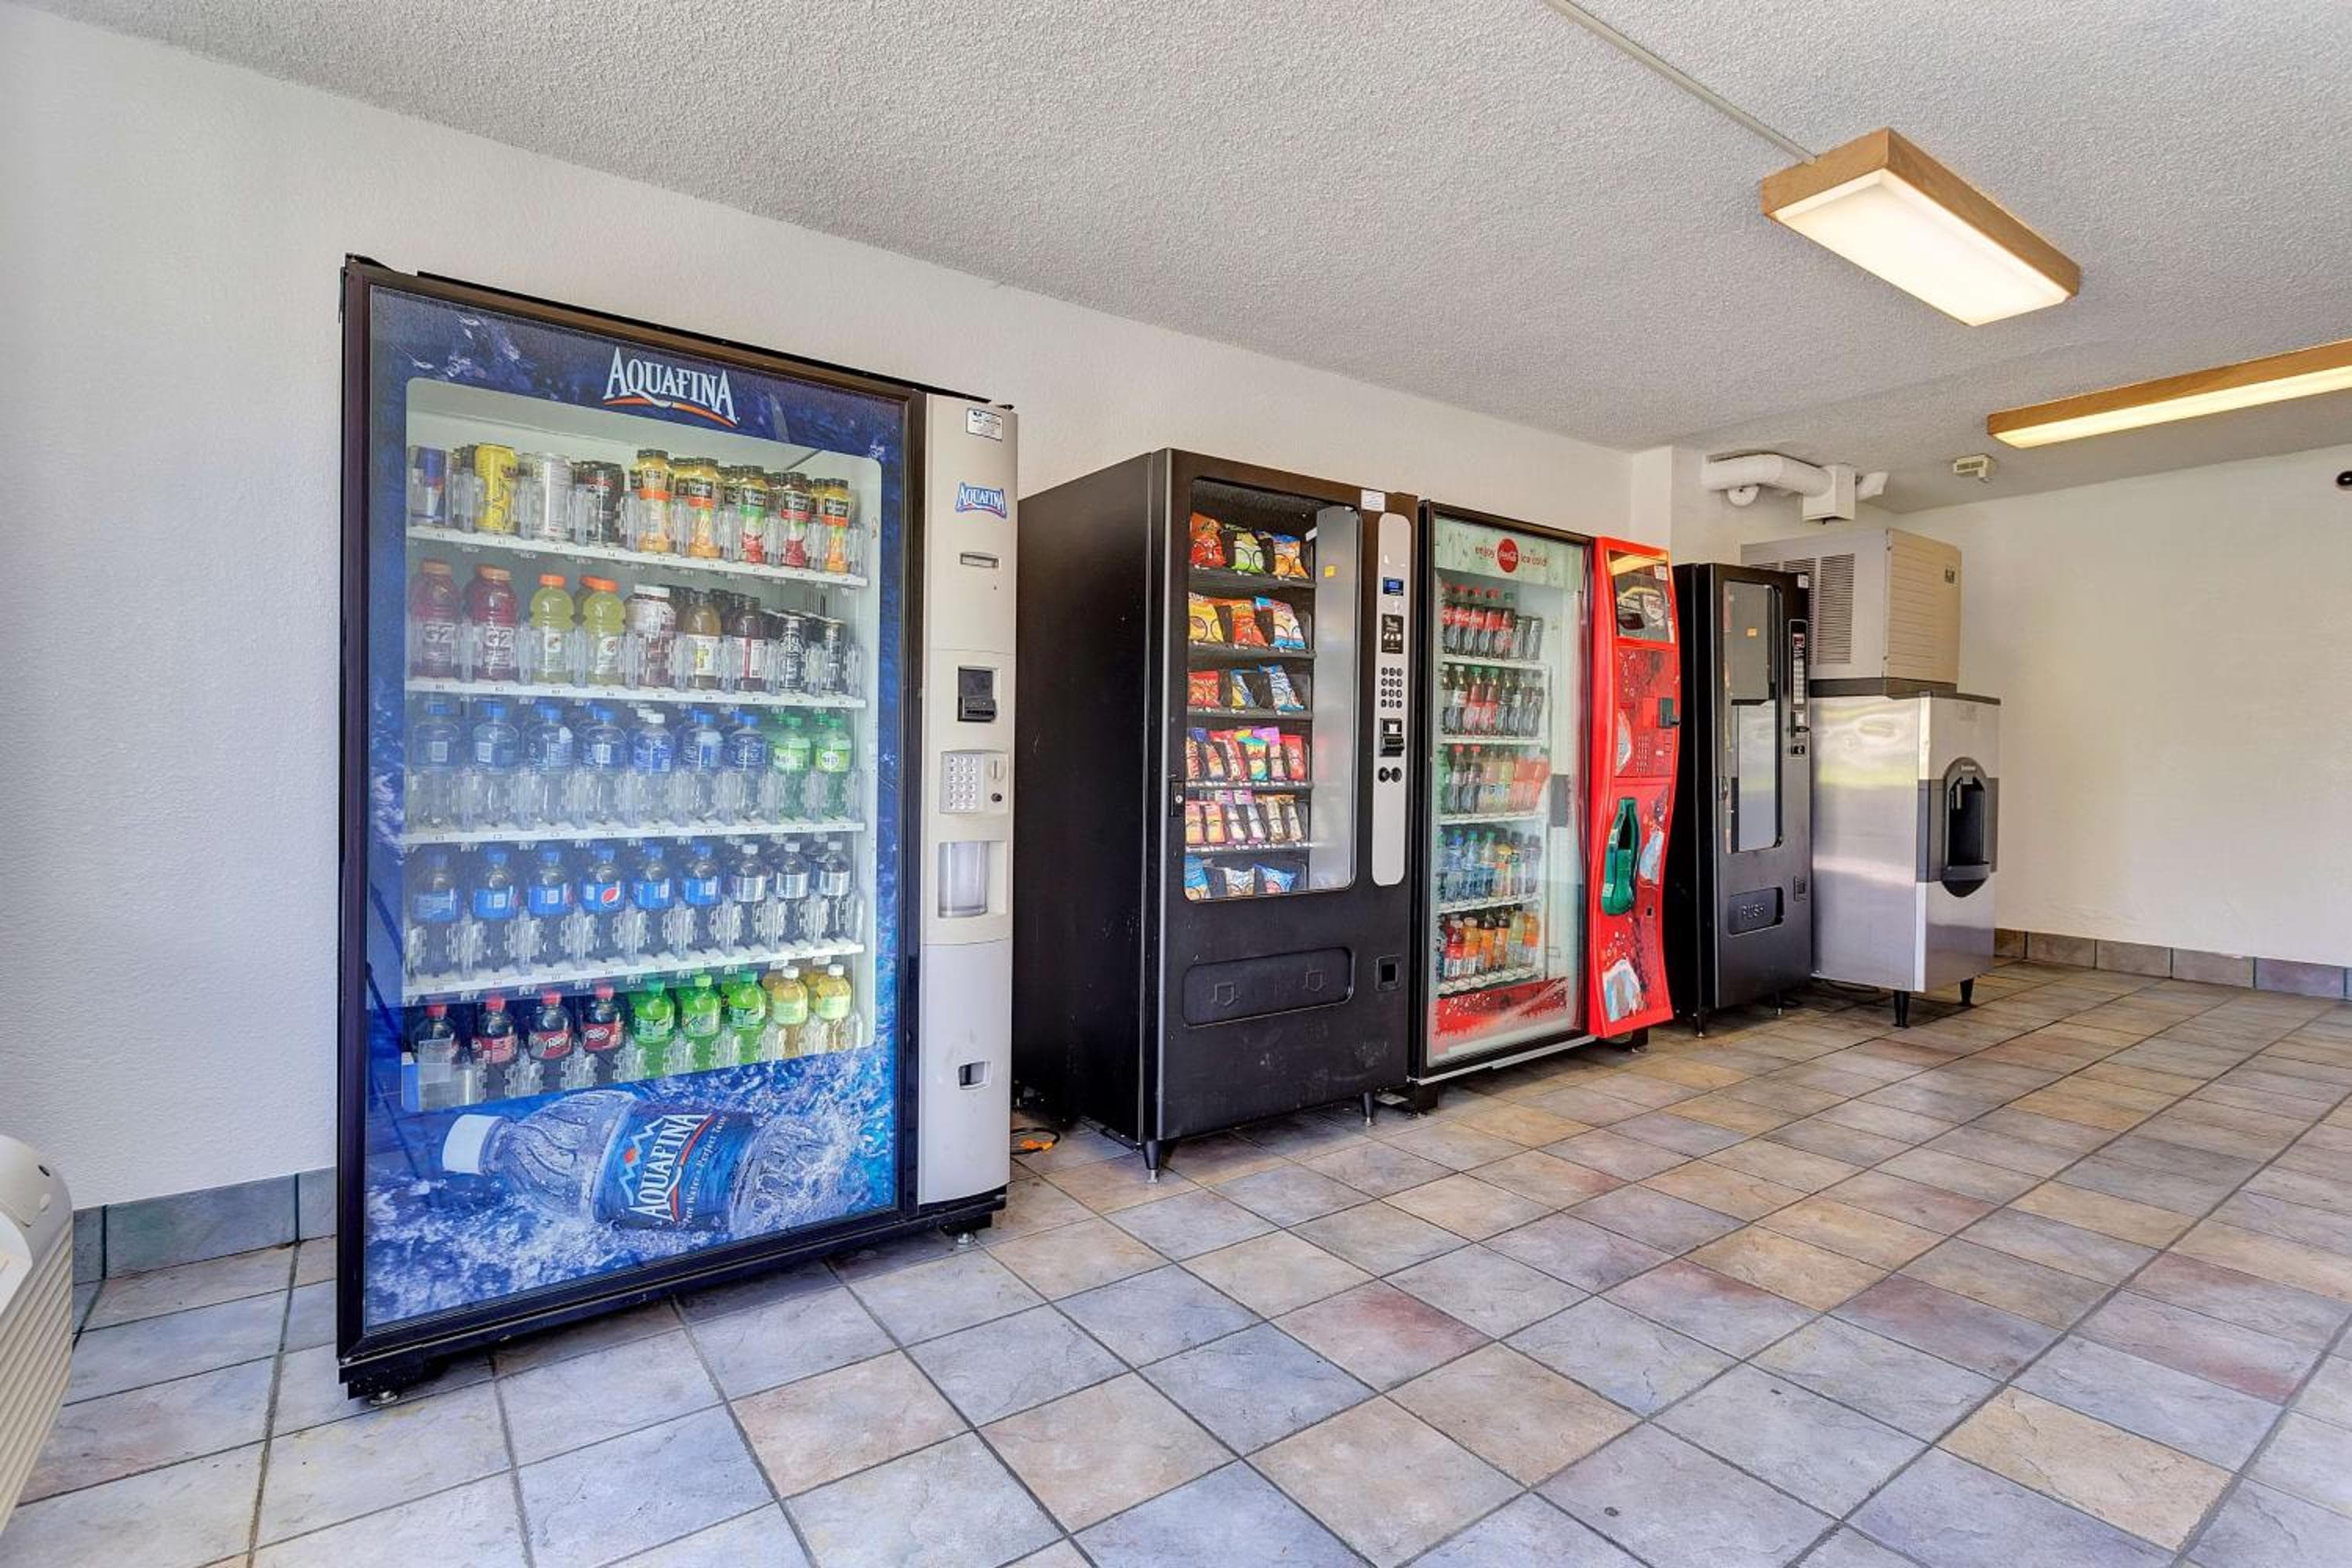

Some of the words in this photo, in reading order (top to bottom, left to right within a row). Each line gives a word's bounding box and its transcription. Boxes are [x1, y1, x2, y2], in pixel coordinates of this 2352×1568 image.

[602, 346, 738, 424] AQUAFINA
[956, 483, 1005, 511] AQUAFINA
[1475, 546, 1496, 559] enjoy
[628, 1114, 712, 1222] AQUAFINA
